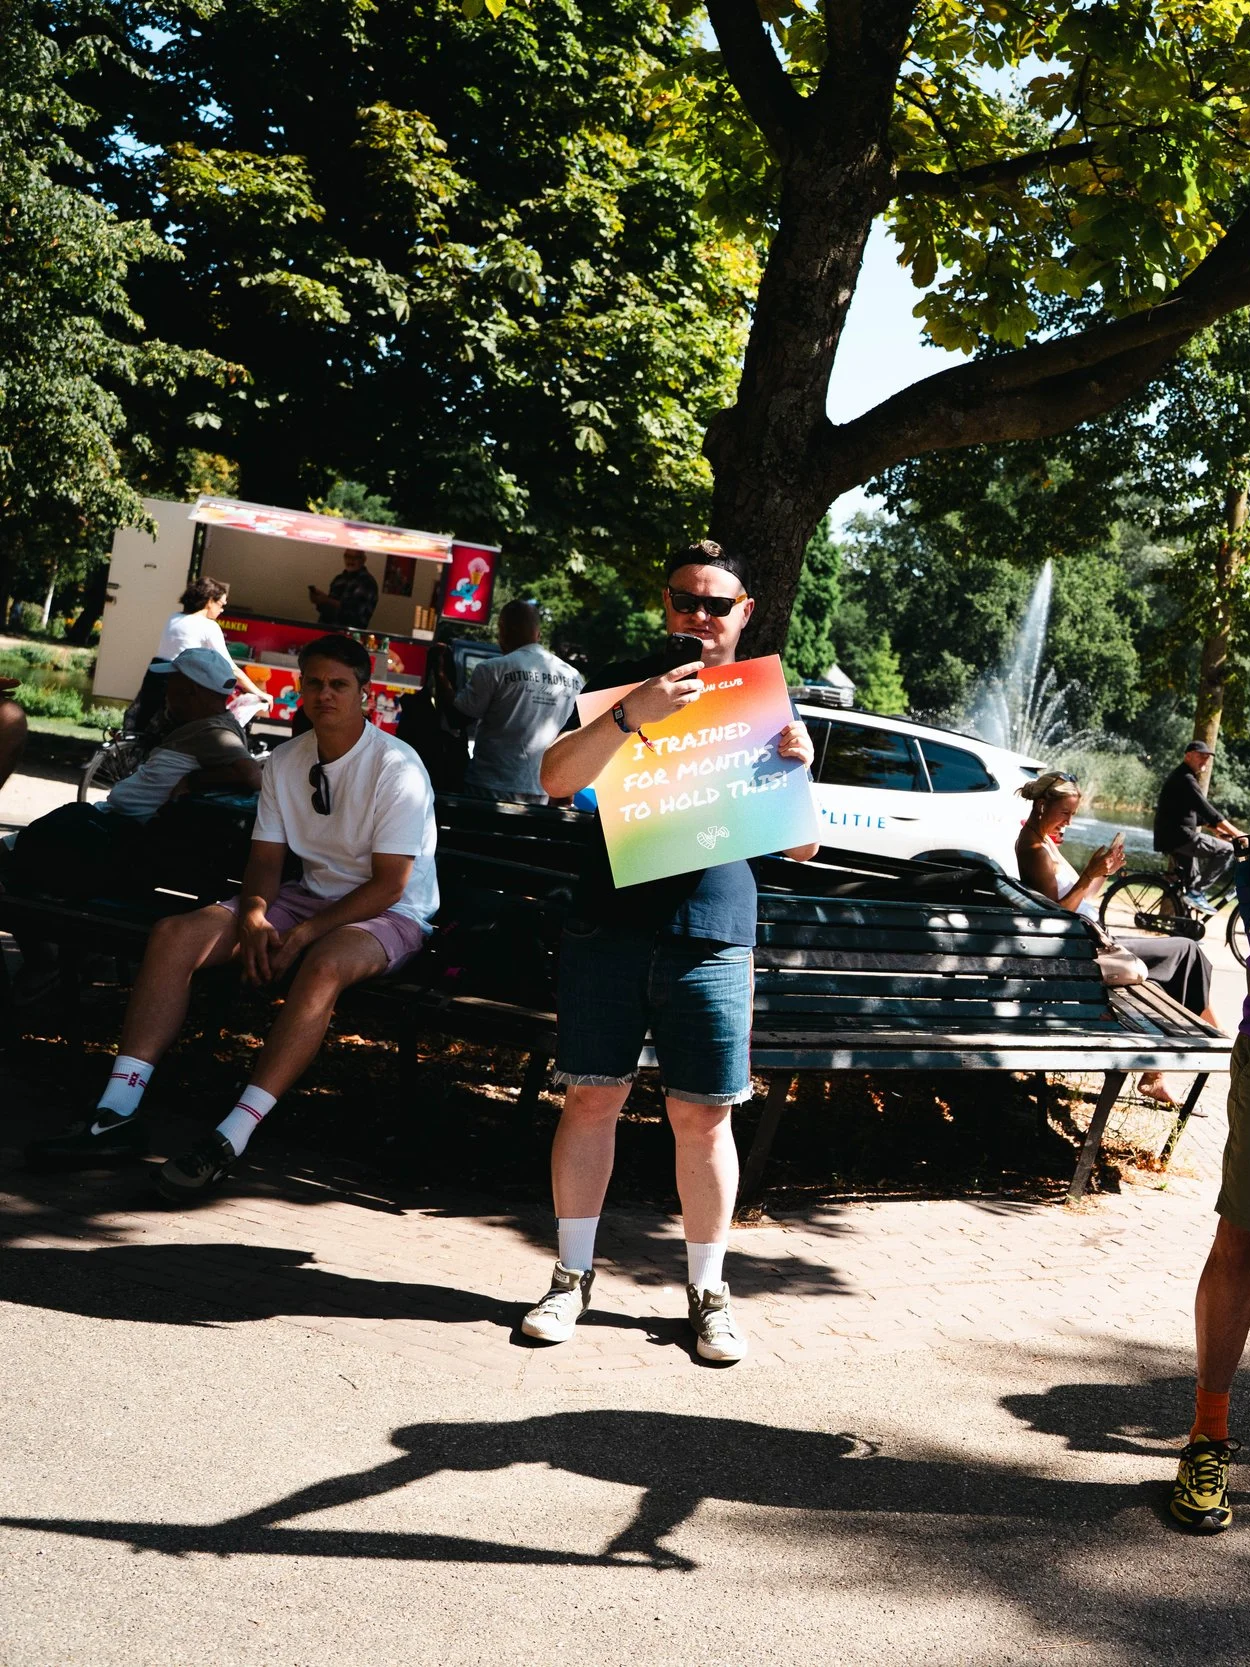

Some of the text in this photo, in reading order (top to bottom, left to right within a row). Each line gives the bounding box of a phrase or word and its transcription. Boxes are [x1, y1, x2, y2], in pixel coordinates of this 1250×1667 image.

[504, 670, 540, 685] FUTURE
[718, 677, 744, 689] CLUB
[632, 722, 751, 761] I TRAINED
[623, 744, 774, 792] FOR MONTHS
[619, 770, 788, 822] TO HOLD THIS!
